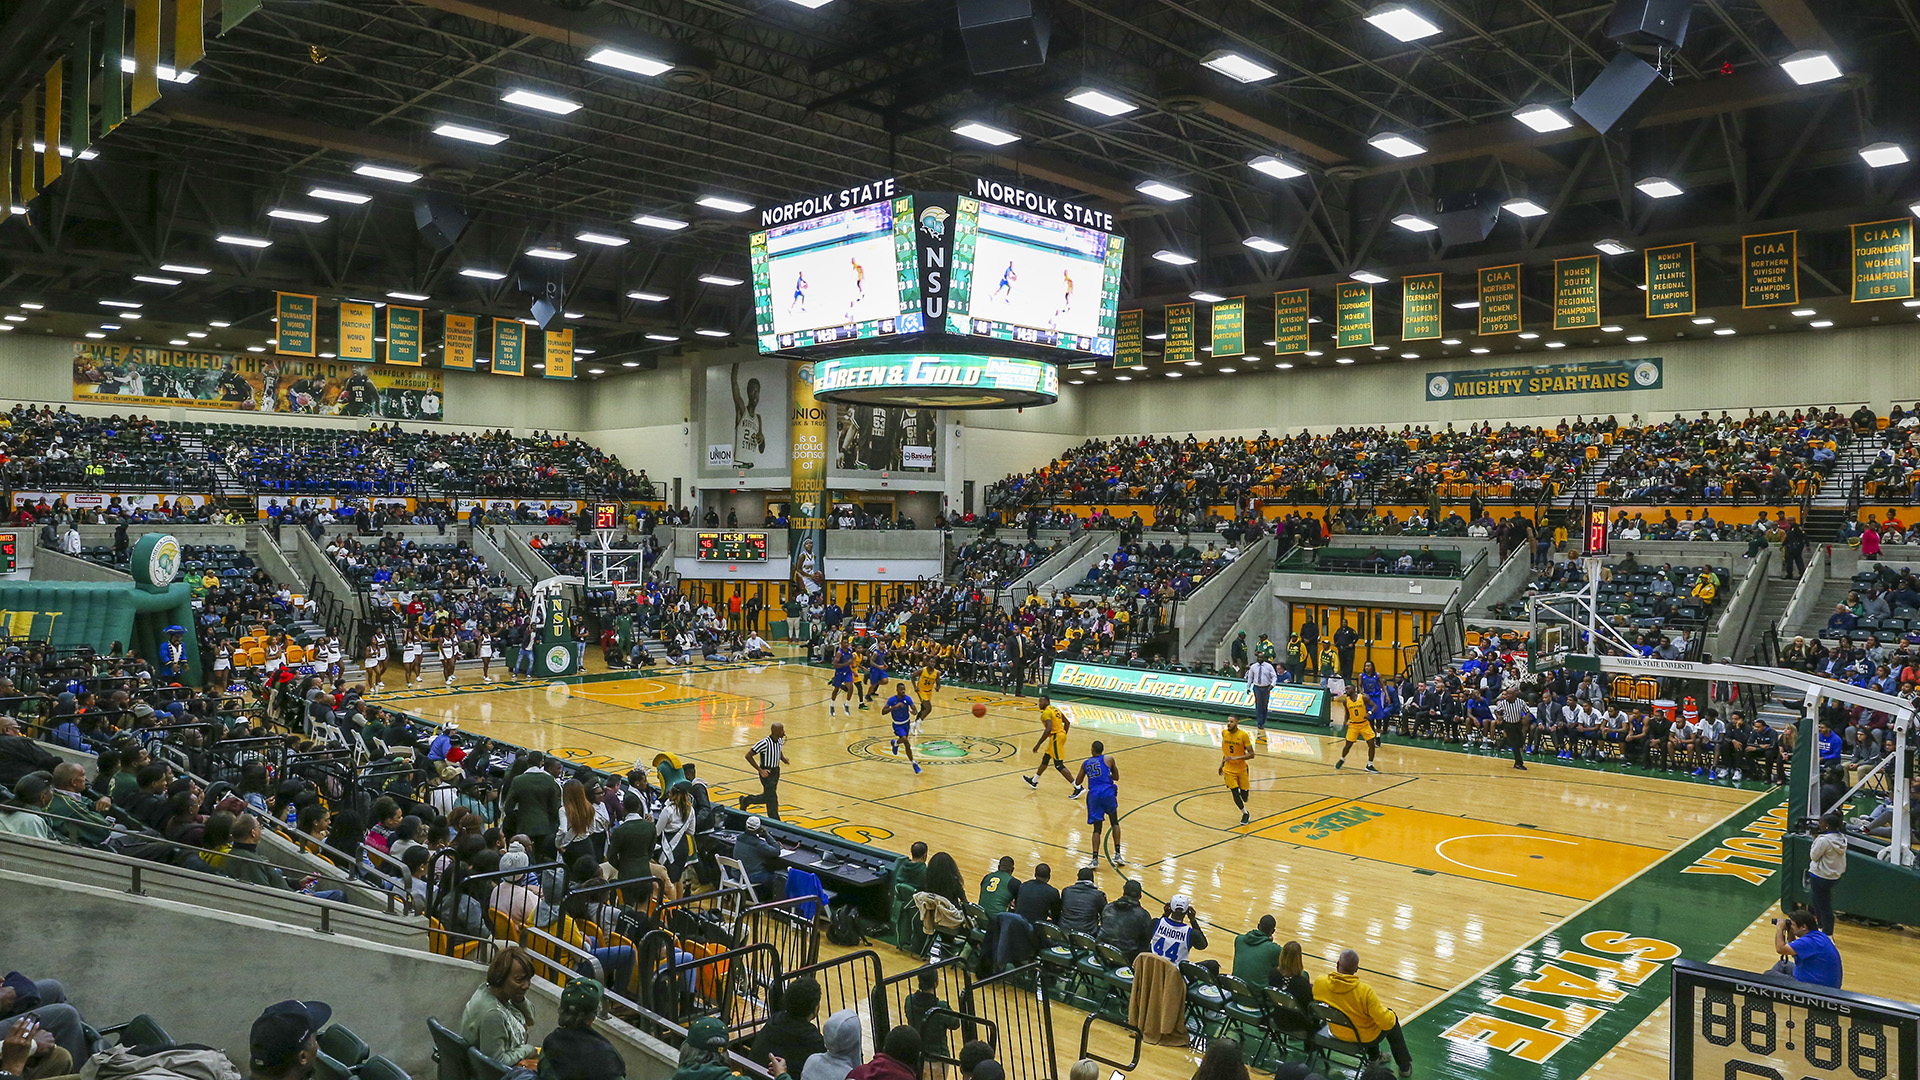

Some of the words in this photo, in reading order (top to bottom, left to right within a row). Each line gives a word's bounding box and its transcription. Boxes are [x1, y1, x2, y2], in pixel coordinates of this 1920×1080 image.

[761, 193, 833, 227] NORFOLK
[839, 178, 895, 208] STATE
[896, 199, 909, 213] HU
[959, 199, 978, 214] NSU
[977, 178, 1057, 216] NORFOLK
[1063, 203, 1113, 231] STATE
[1864, 228, 1901, 242] CIAA
[752, 234, 766, 246] NSU
[1110, 237, 1121, 250] HU
[1753, 243, 1785, 255] CIAA
[1856, 243, 1910, 257] TOURNAMENT
[1658, 252, 1681, 261] WOMEN
[1659, 262, 1681, 270] SOUTH
[1751, 259, 1789, 267] NORTHERN
[1865, 258, 1901, 268] WOMEN
[1564, 268, 1590, 277] WOMEN
[1655, 271, 1686, 280] ATLANTIC
[1753, 267, 1786, 276] DIVISION
[1487, 272, 1511, 282] CIAA
[1757, 276, 1783, 284] WOMEN
[1857, 271, 1908, 282] CHAMPIONS
[926, 247, 944, 318] NSU
[1410, 281, 1435, 290] CIAA
[1564, 278, 1590, 286] SOUTH
[1653, 281, 1685, 291] REGIONAL
[1483, 283, 1515, 293] NORTHERN
[1559, 287, 1594, 296] ATLANTIC
[1750, 283, 1791, 293] CHAMPIONS
[1870, 285, 1896, 294] 1995
[1343, 289, 1366, 298] CIAA
[1406, 293, 1439, 302] TOURNAMENT
[1652, 291, 1689, 301] CHAMPIONS
[1281, 296, 1303, 305] CIAA
[1485, 294, 1513, 303] DIVISION
[1558, 297, 1594, 306] REGIONAL
[1338, 301, 1370, 310] TOURNAMENT
[1412, 304, 1433, 312] WOMEN
[1488, 304, 1510, 312] WOMEN
[1168, 307, 1191, 316] NCAA
[1277, 306, 1307, 315] NORTHERN
[1557, 306, 1596, 315] CHAMPIONS
[281, 312, 312, 321] TOURNAMENT
[1169, 316, 1191, 324] QUARTER
[1280, 316, 1304, 324] DIVISION
[1406, 314, 1438, 323] CHAMPIONS
[1482, 314, 1517, 324] CHAMPIONS
[1567, 316, 1586, 324] 1993
[287, 321, 305, 329] WOMEN
[341, 321, 371, 329] PARTICIPANT
[1339, 322, 1371, 331] CHAMPIONS
[282, 330, 310, 338] CHAMPIONS
[1214, 332, 1242, 340] PARTICIPANT
[1277, 334, 1307, 343] CHAMPIONS
[1116, 347, 1140, 355] CHAMPIONS
[133, 347, 222, 371] SHOCKED
[373, 368, 405, 378] NORFOLK
[408, 371, 429, 379] STATE
[823, 360, 885, 390] GREEN
[886, 367, 904, 385] &
[906, 356, 981, 386] GOLD
[1489, 368, 1530, 378] HOME
[1535, 367, 1554, 375] OF
[1558, 366, 1588, 374] THE
[395, 379, 429, 388] MISSOURI
[1454, 379, 1523, 397] MIGHTY
[1529, 372, 1630, 394] SPARTANS
[799, 434, 806, 443] is
[809, 435, 817, 443] a
[794, 442, 823, 452] proud
[710, 450, 731, 460] UNION
[911, 452, 932, 460] Banister
[802, 460, 814, 470] of
[795, 492, 820, 504] STATE
[597, 513, 614, 528] 27
[723, 533, 743, 541] 14:58
[1591, 526, 1604, 550] 27
[701, 540, 713, 548] 46
[754, 540, 765, 549] 45
[3, 544, 15, 555] 45
[552, 599, 564, 637] NSU
[1616, 658, 1642, 667] NORFOLK
[1643, 660, 1660, 668] STATE
[1661, 662, 1694, 671] UNIVERSITY
[1057, 664, 1117, 691] BEHOLD
[1117, 681, 1136, 693] THE
[1134, 674, 1192, 700] GREEN
[1193, 686, 1206, 701] &
[1206, 681, 1257, 707] GOLD
[1269, 687, 1311, 702] NORFOLK
[1277, 698, 1306, 709] STATE
[1229, 745, 1234, 754] 5
[1086, 762, 1101, 777] 25
[985, 877, 1000, 892] 3
[1157, 924, 1187, 942] MAHORN
[1153, 937, 1180, 963] 44
[1438, 930, 1682, 1065] STATE
[1736, 983, 1852, 1014] DAKTRONICS
